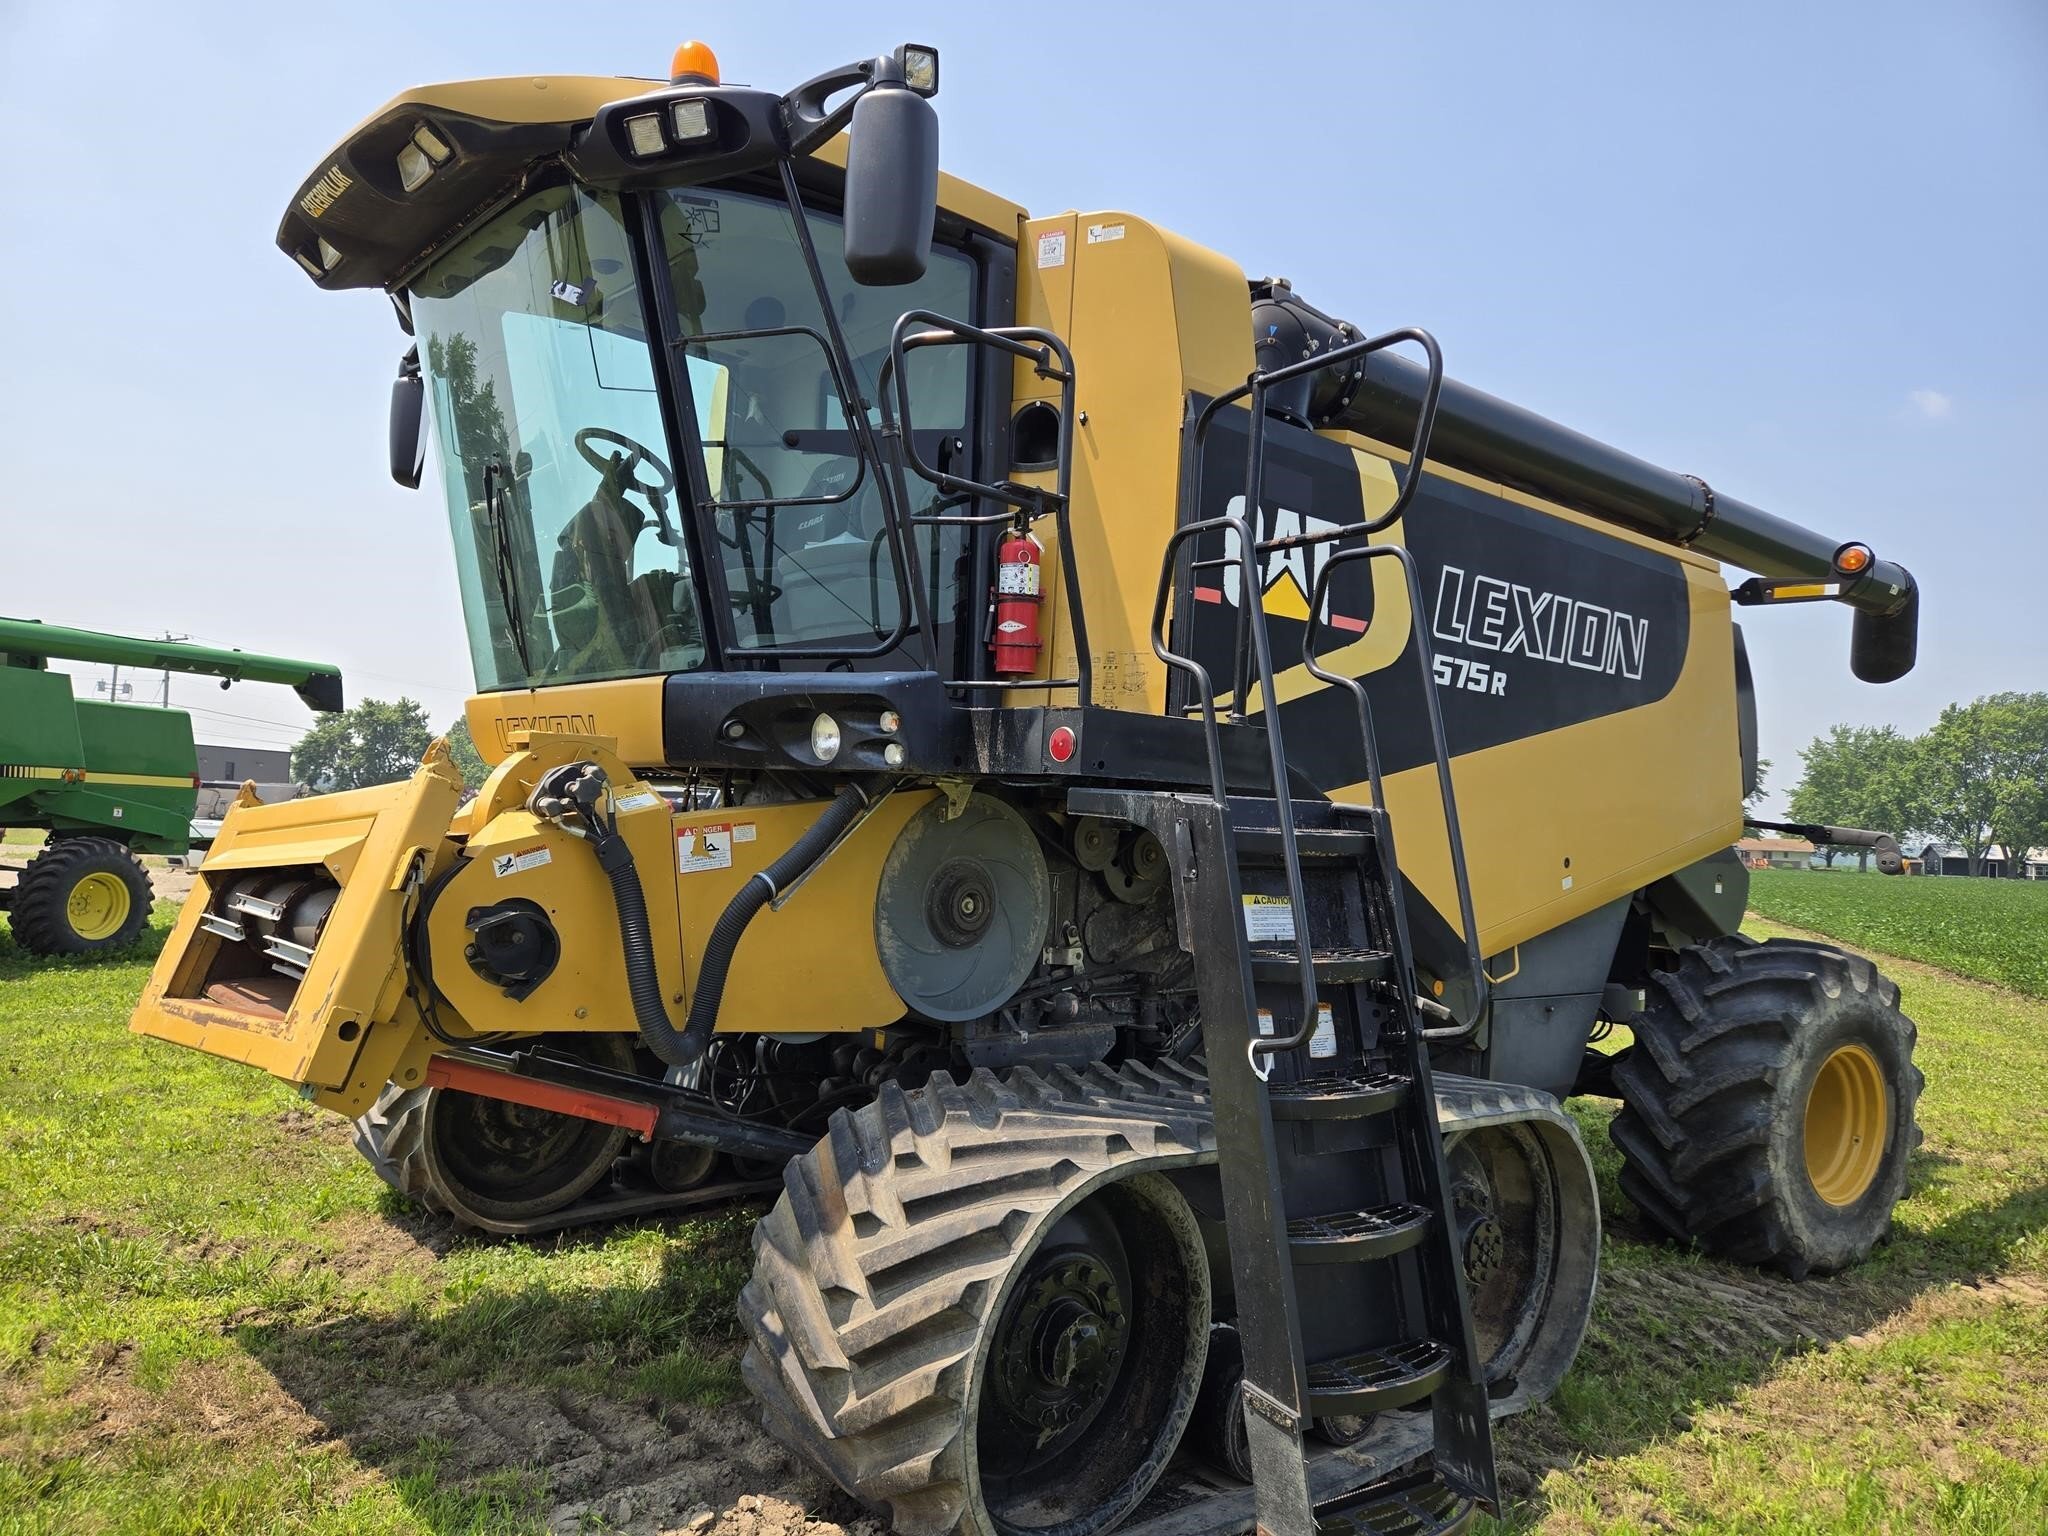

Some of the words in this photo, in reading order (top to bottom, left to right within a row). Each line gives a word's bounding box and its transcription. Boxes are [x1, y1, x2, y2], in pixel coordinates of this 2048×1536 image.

[300, 164, 353, 218] CATERPILLAR
[1223, 495, 1340, 625] CAT
[1433, 564, 1649, 680] LEXION
[693, 825, 723, 835] DNGER
[521, 844, 547, 856] WARNING
[1260, 895, 1292, 905] CAUTIO
